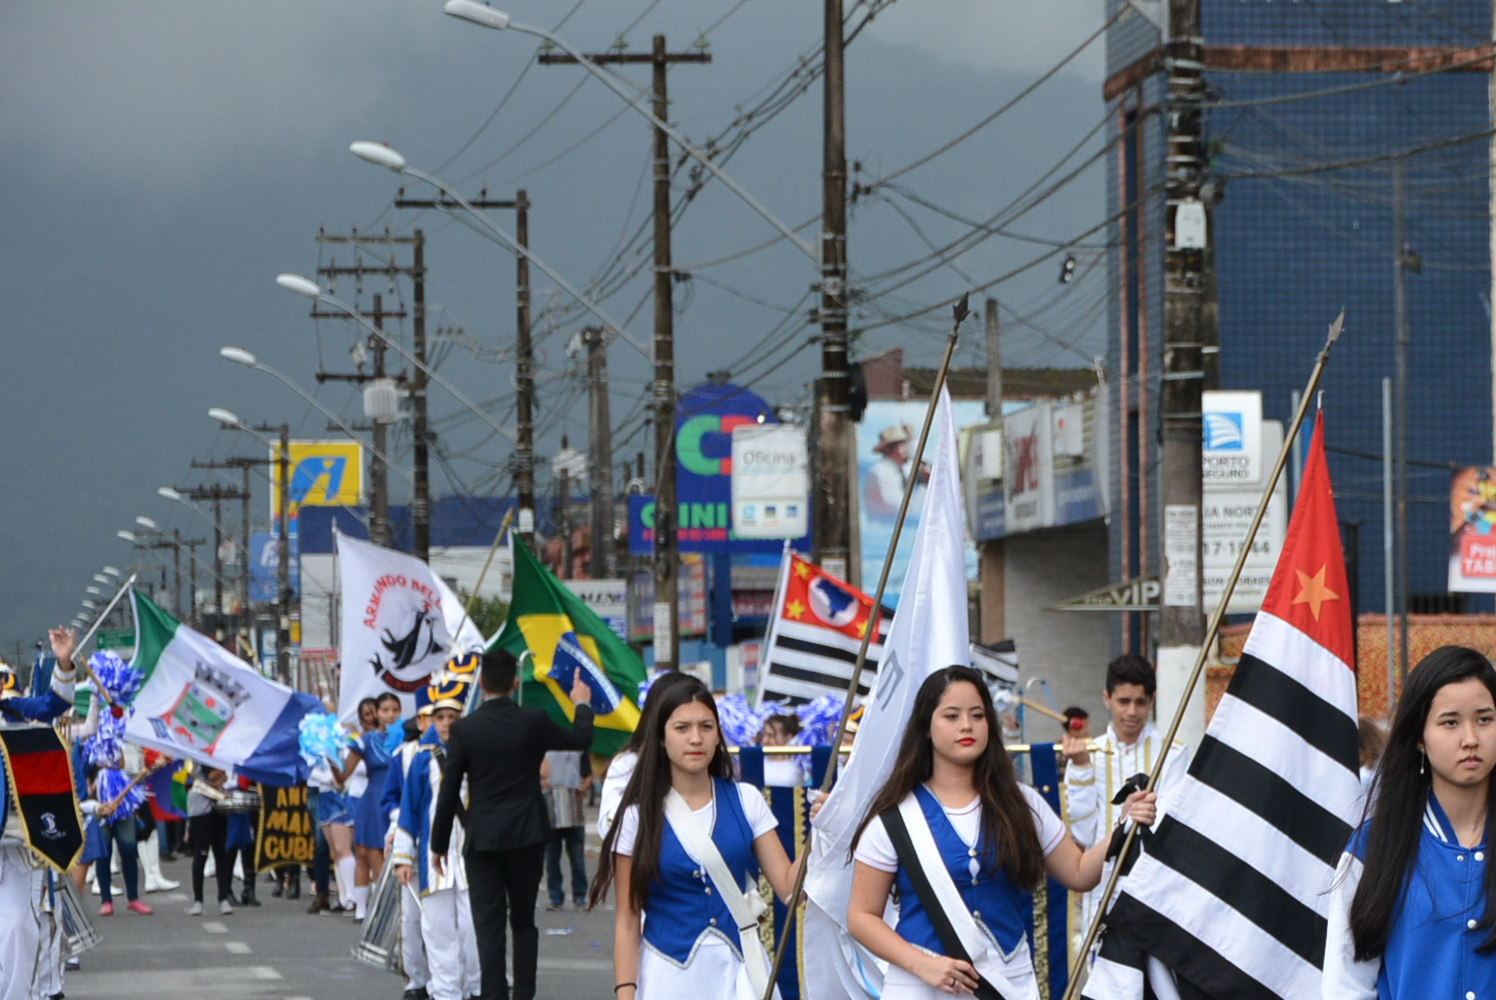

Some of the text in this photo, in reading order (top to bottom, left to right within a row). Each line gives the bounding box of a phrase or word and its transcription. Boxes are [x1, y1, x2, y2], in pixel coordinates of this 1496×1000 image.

[743, 451, 796, 466] Oficina
[363, 573, 408, 630] ARMINDO
[1110, 580, 1160, 605] VIP
